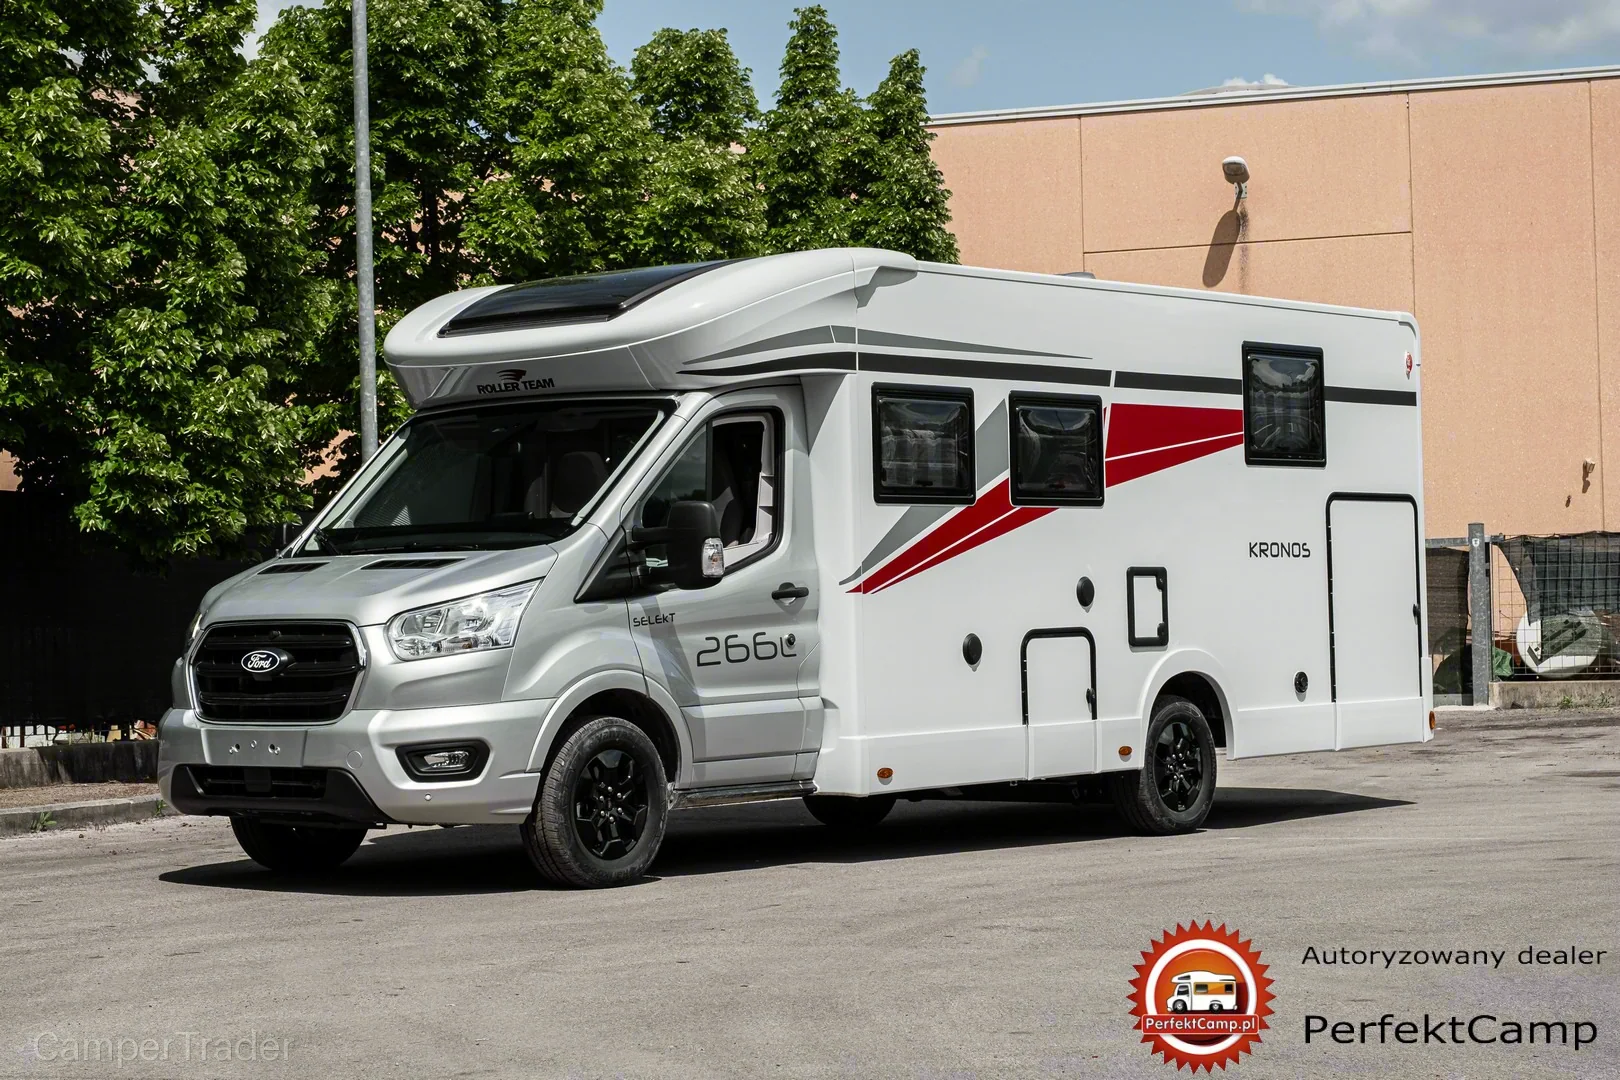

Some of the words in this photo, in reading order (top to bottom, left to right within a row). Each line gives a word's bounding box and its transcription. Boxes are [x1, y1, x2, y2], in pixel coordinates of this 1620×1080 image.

[476, 382, 520, 394] ROLLER
[521, 378, 555, 390] TEAM
[1249, 542, 1311, 558] KRONOS
[696, 631, 797, 667] 266L
[247, 653, 273, 669] Ford
